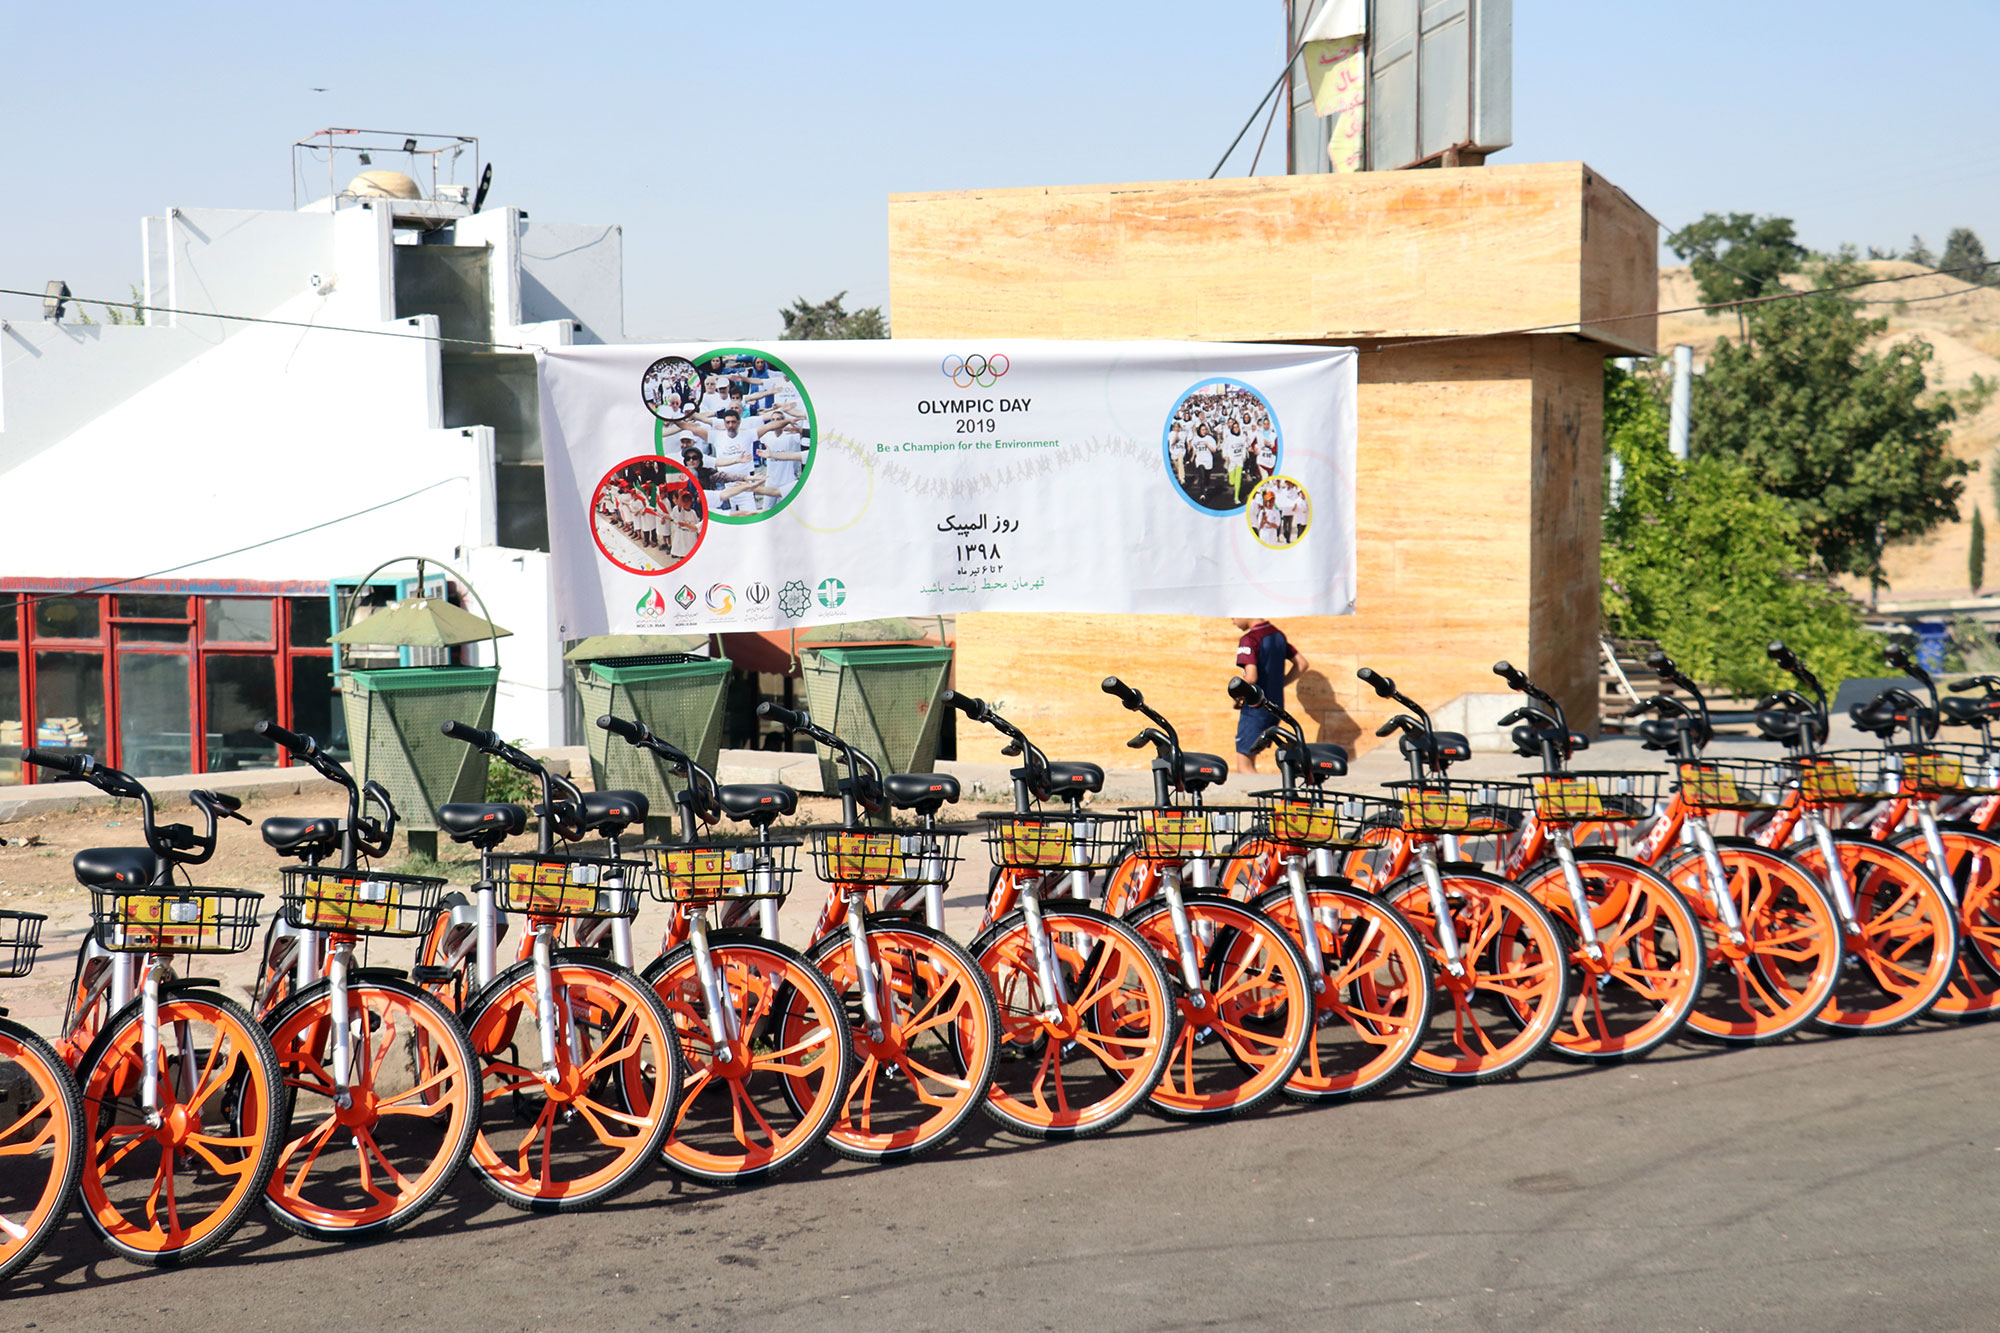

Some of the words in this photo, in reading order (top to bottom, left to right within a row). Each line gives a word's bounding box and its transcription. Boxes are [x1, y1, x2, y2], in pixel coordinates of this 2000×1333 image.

[917, 399, 994, 414] OLYMPIC
[999, 398, 1032, 413] DAY
[956, 418, 996, 434] 2019
[876, 442, 891, 453] Be
[893, 444, 900, 453] a
[902, 441, 955, 454] Champion
[958, 440, 973, 451] for
[975, 440, 992, 450] the
[995, 438, 1060, 449] Environment
[937, 513, 987, 537] المپیک
[992, 515, 1019, 534] روز
[956, 543, 1001, 562] ۱۳۹۸
[957, 566, 967, 575] ماه
[969, 567, 980, 577] تیر
[989, 565, 996, 574] تا
[920, 580, 944, 595] باشید
[948, 580, 977, 593] زیست
[981, 577, 1008, 591] محیط
[1012, 576, 1045, 590] قهرمان
